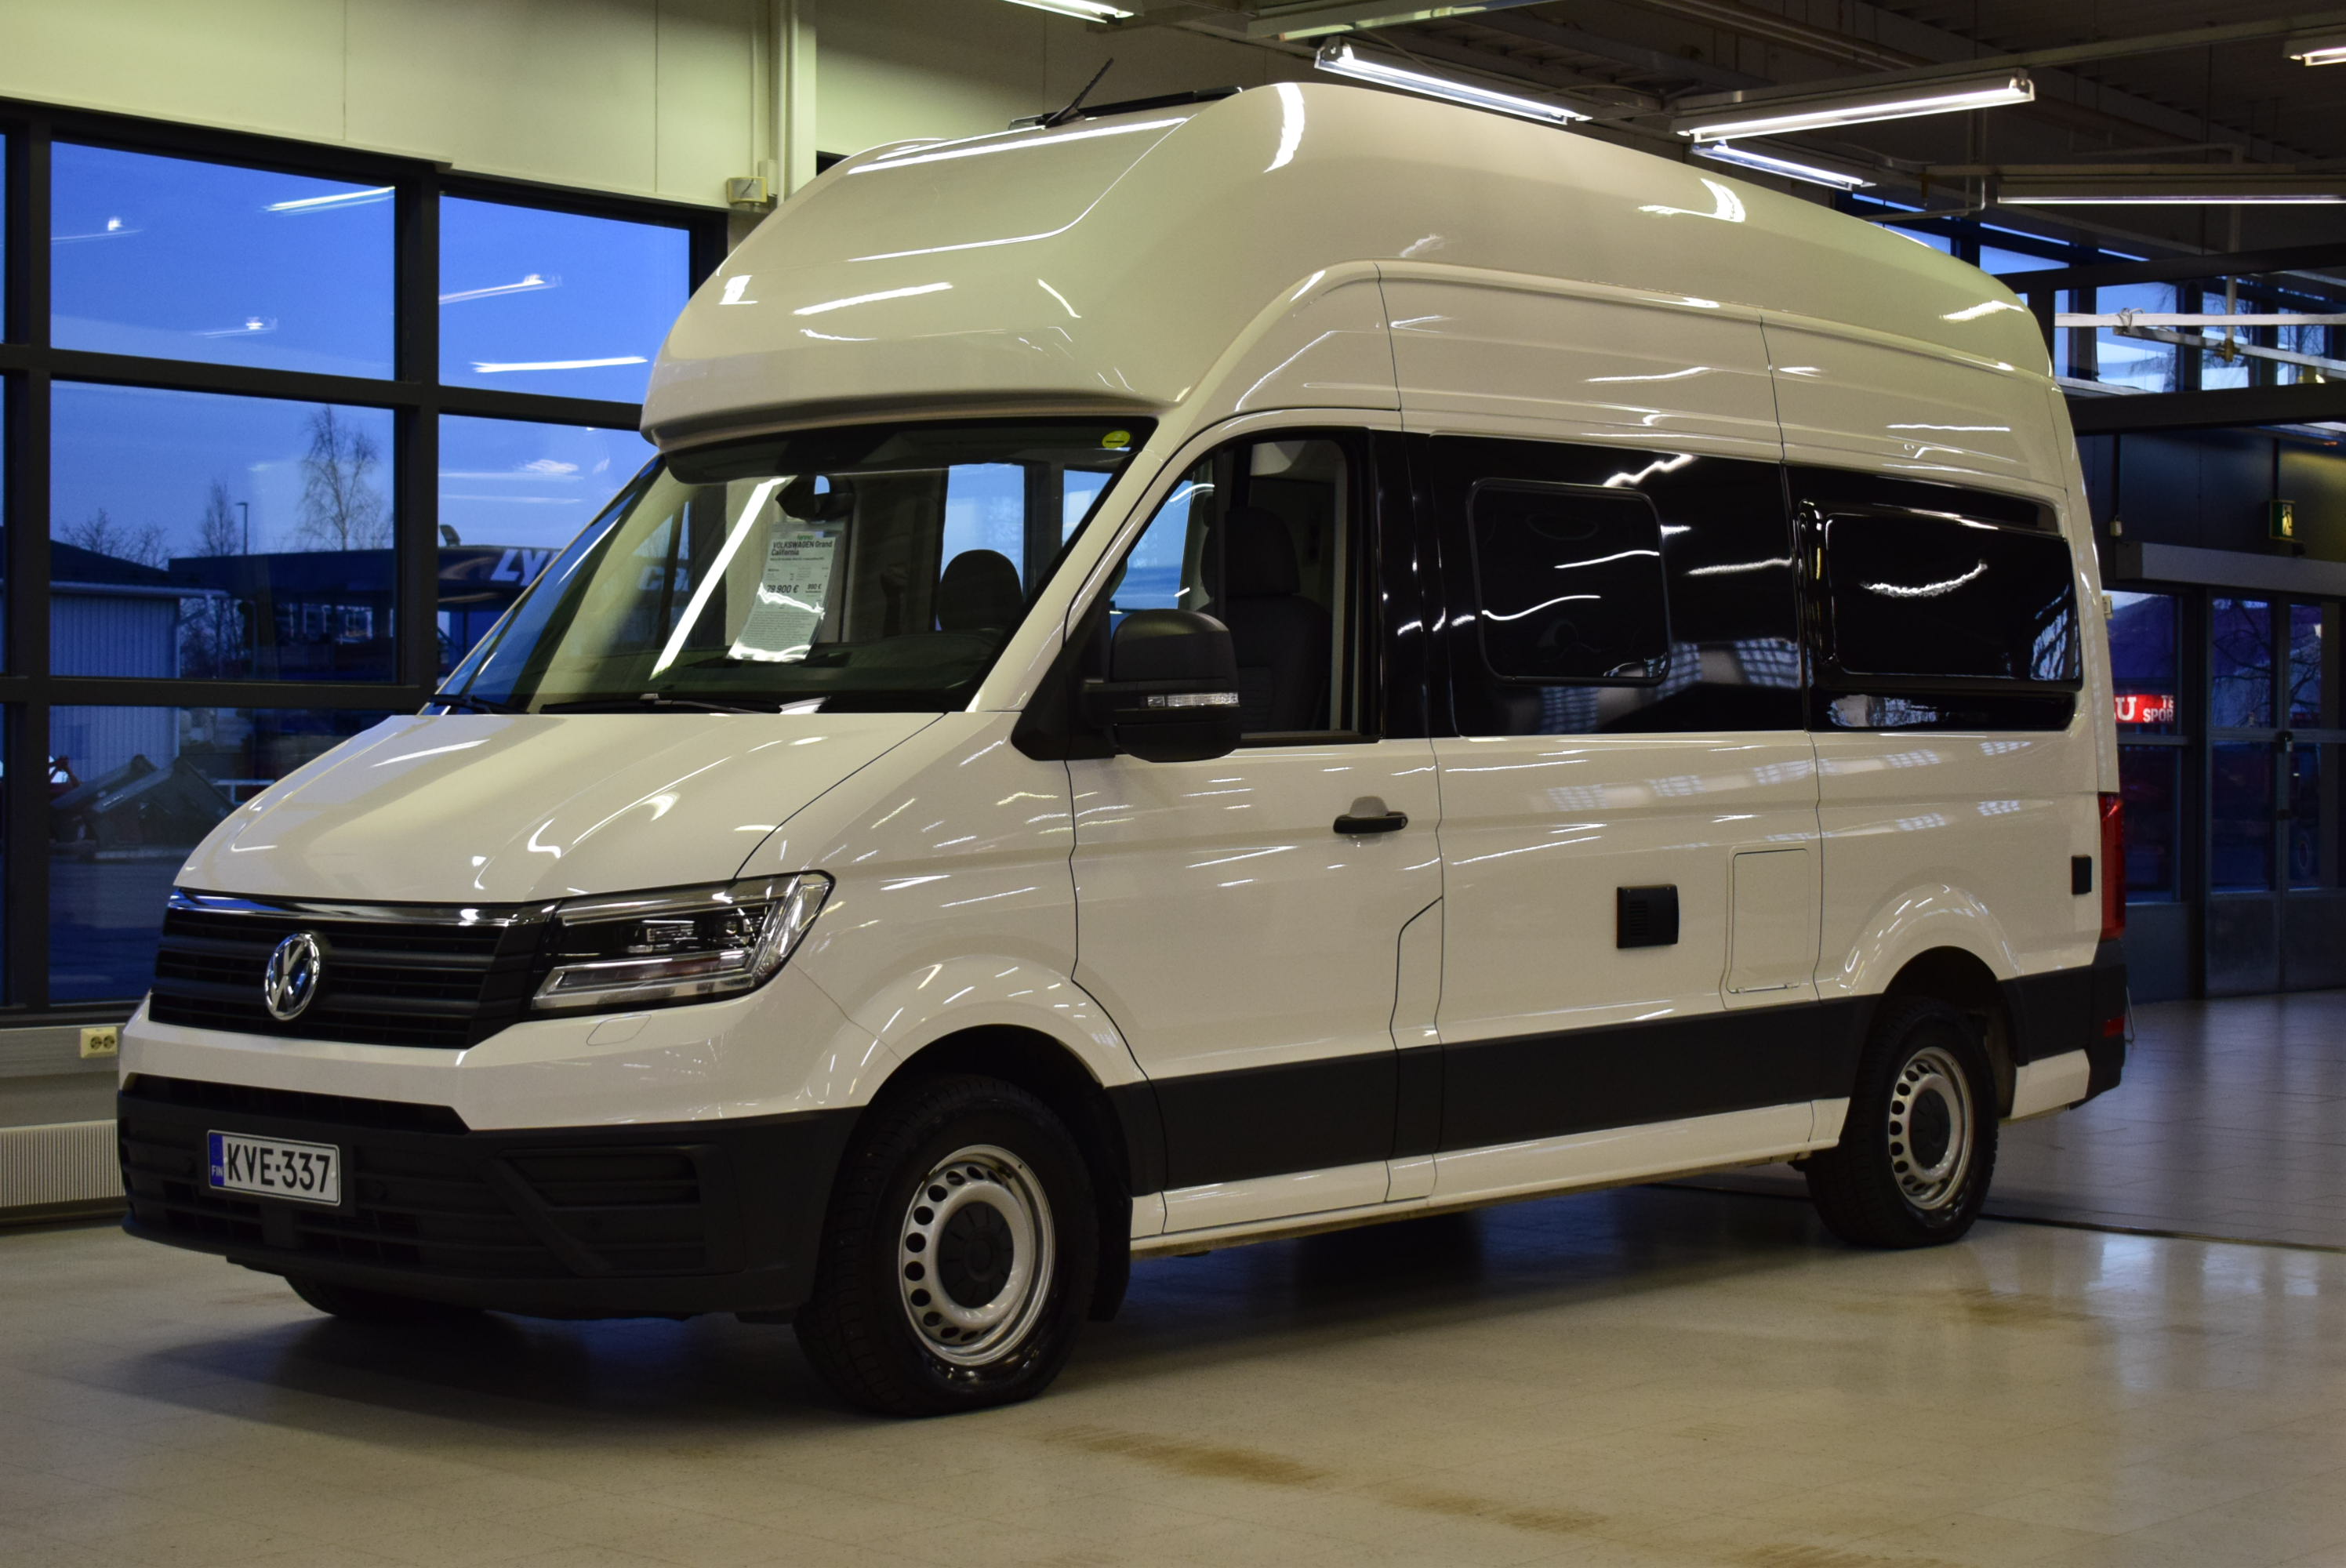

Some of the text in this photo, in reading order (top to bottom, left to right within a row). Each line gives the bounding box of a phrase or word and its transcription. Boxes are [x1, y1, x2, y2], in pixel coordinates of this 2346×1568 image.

[772, 540, 815, 549] VOLKSWAGEN
[776, 584, 792, 593] 900
[793, 584, 800, 593] €
[211, 1164, 223, 1178] FIN
[227, 1142, 331, 1193] KVE-337
